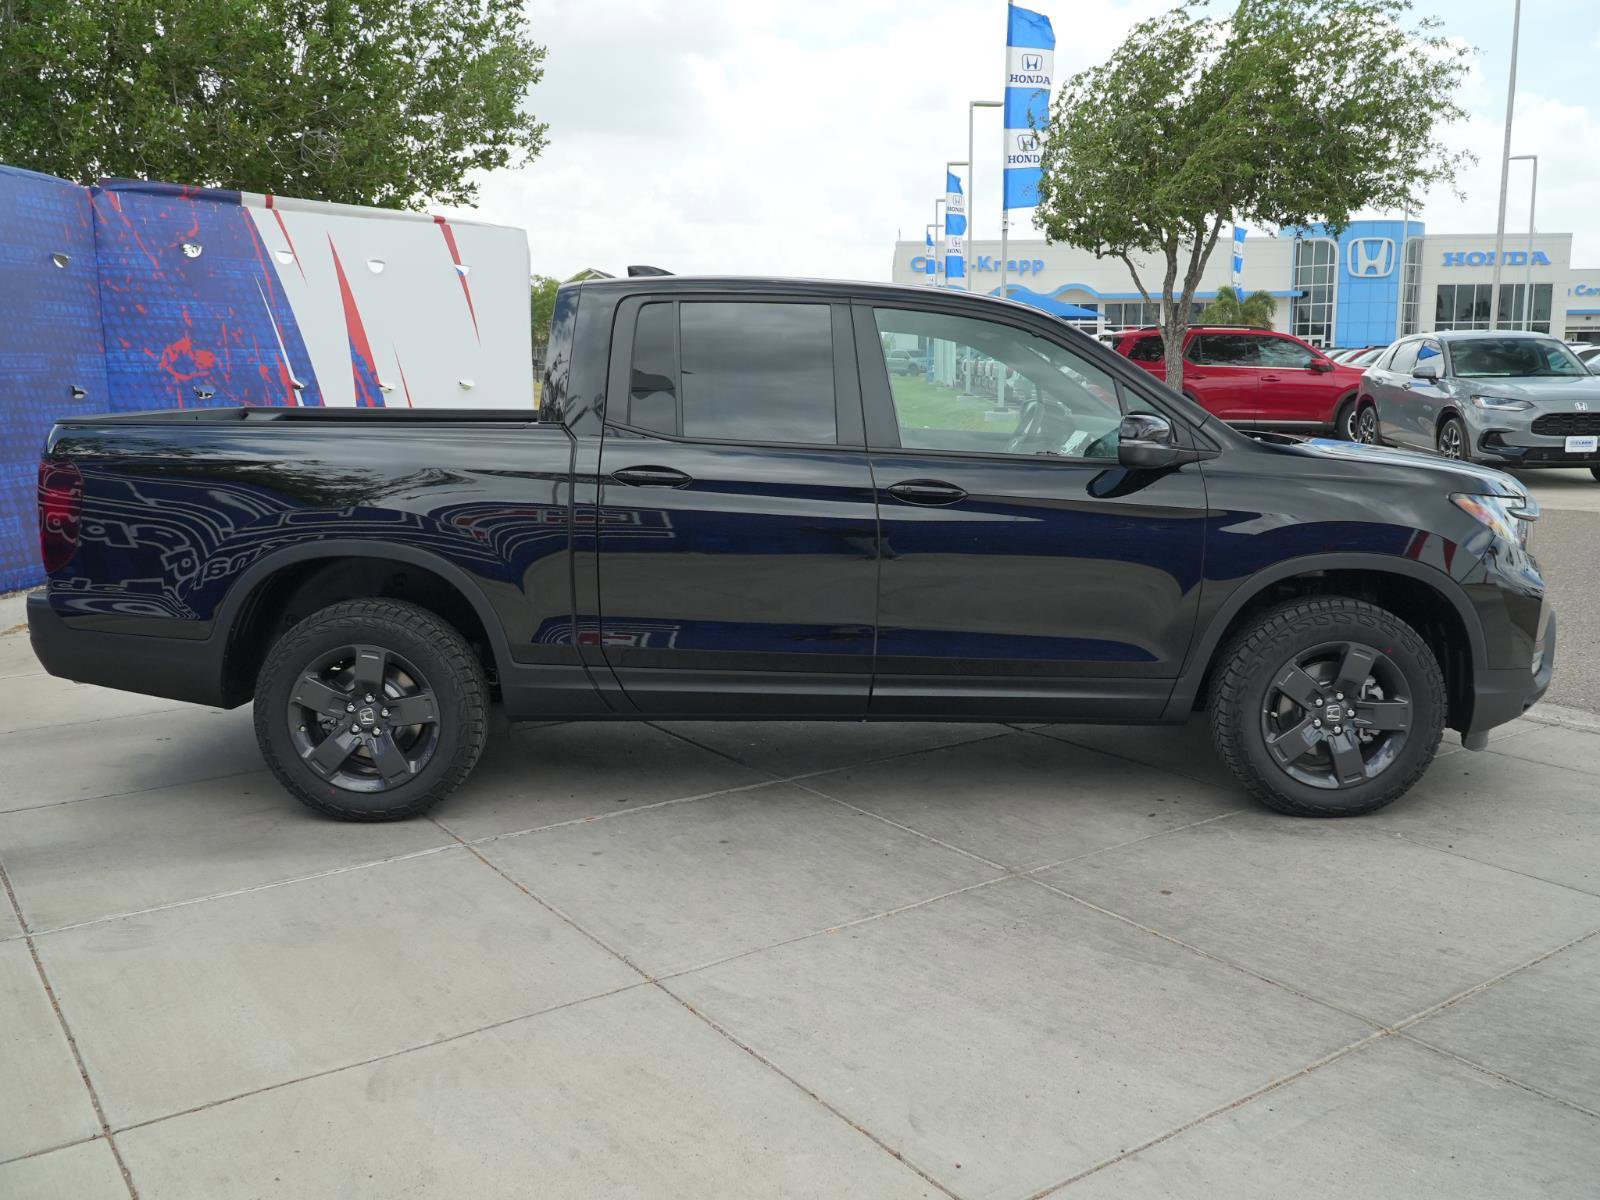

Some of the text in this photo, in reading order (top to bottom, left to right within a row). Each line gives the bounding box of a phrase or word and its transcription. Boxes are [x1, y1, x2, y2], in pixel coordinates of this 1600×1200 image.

[1009, 74, 1051, 85] HONDA
[1007, 154, 1041, 164] HOND
[1442, 251, 1552, 267] HONDA
